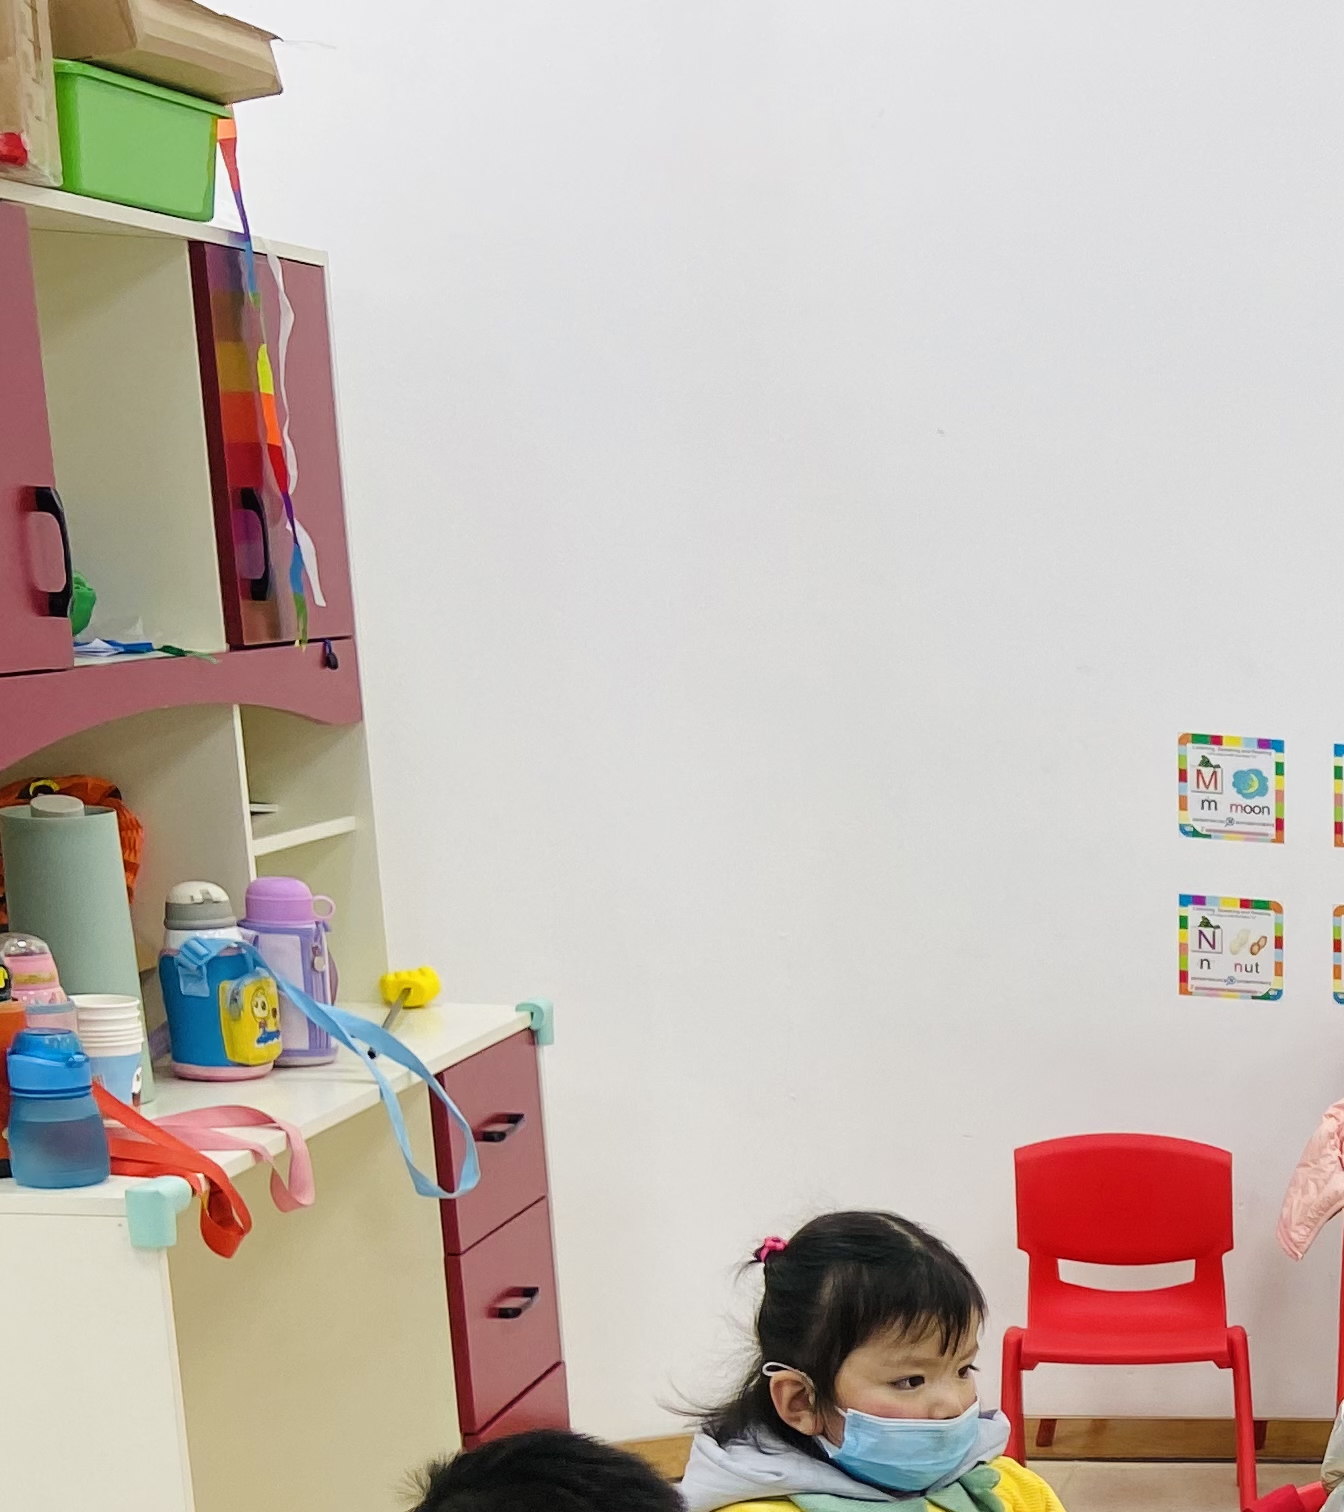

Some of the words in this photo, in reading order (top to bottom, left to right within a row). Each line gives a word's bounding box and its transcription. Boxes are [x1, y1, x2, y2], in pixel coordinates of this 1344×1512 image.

[1196, 769, 1218, 790] M
[1201, 799, 1217, 810] m
[1230, 804, 1270, 815] moon
[1198, 930, 1215, 950] N
[1200, 959, 1211, 970] n
[1234, 962, 1260, 973] nut
